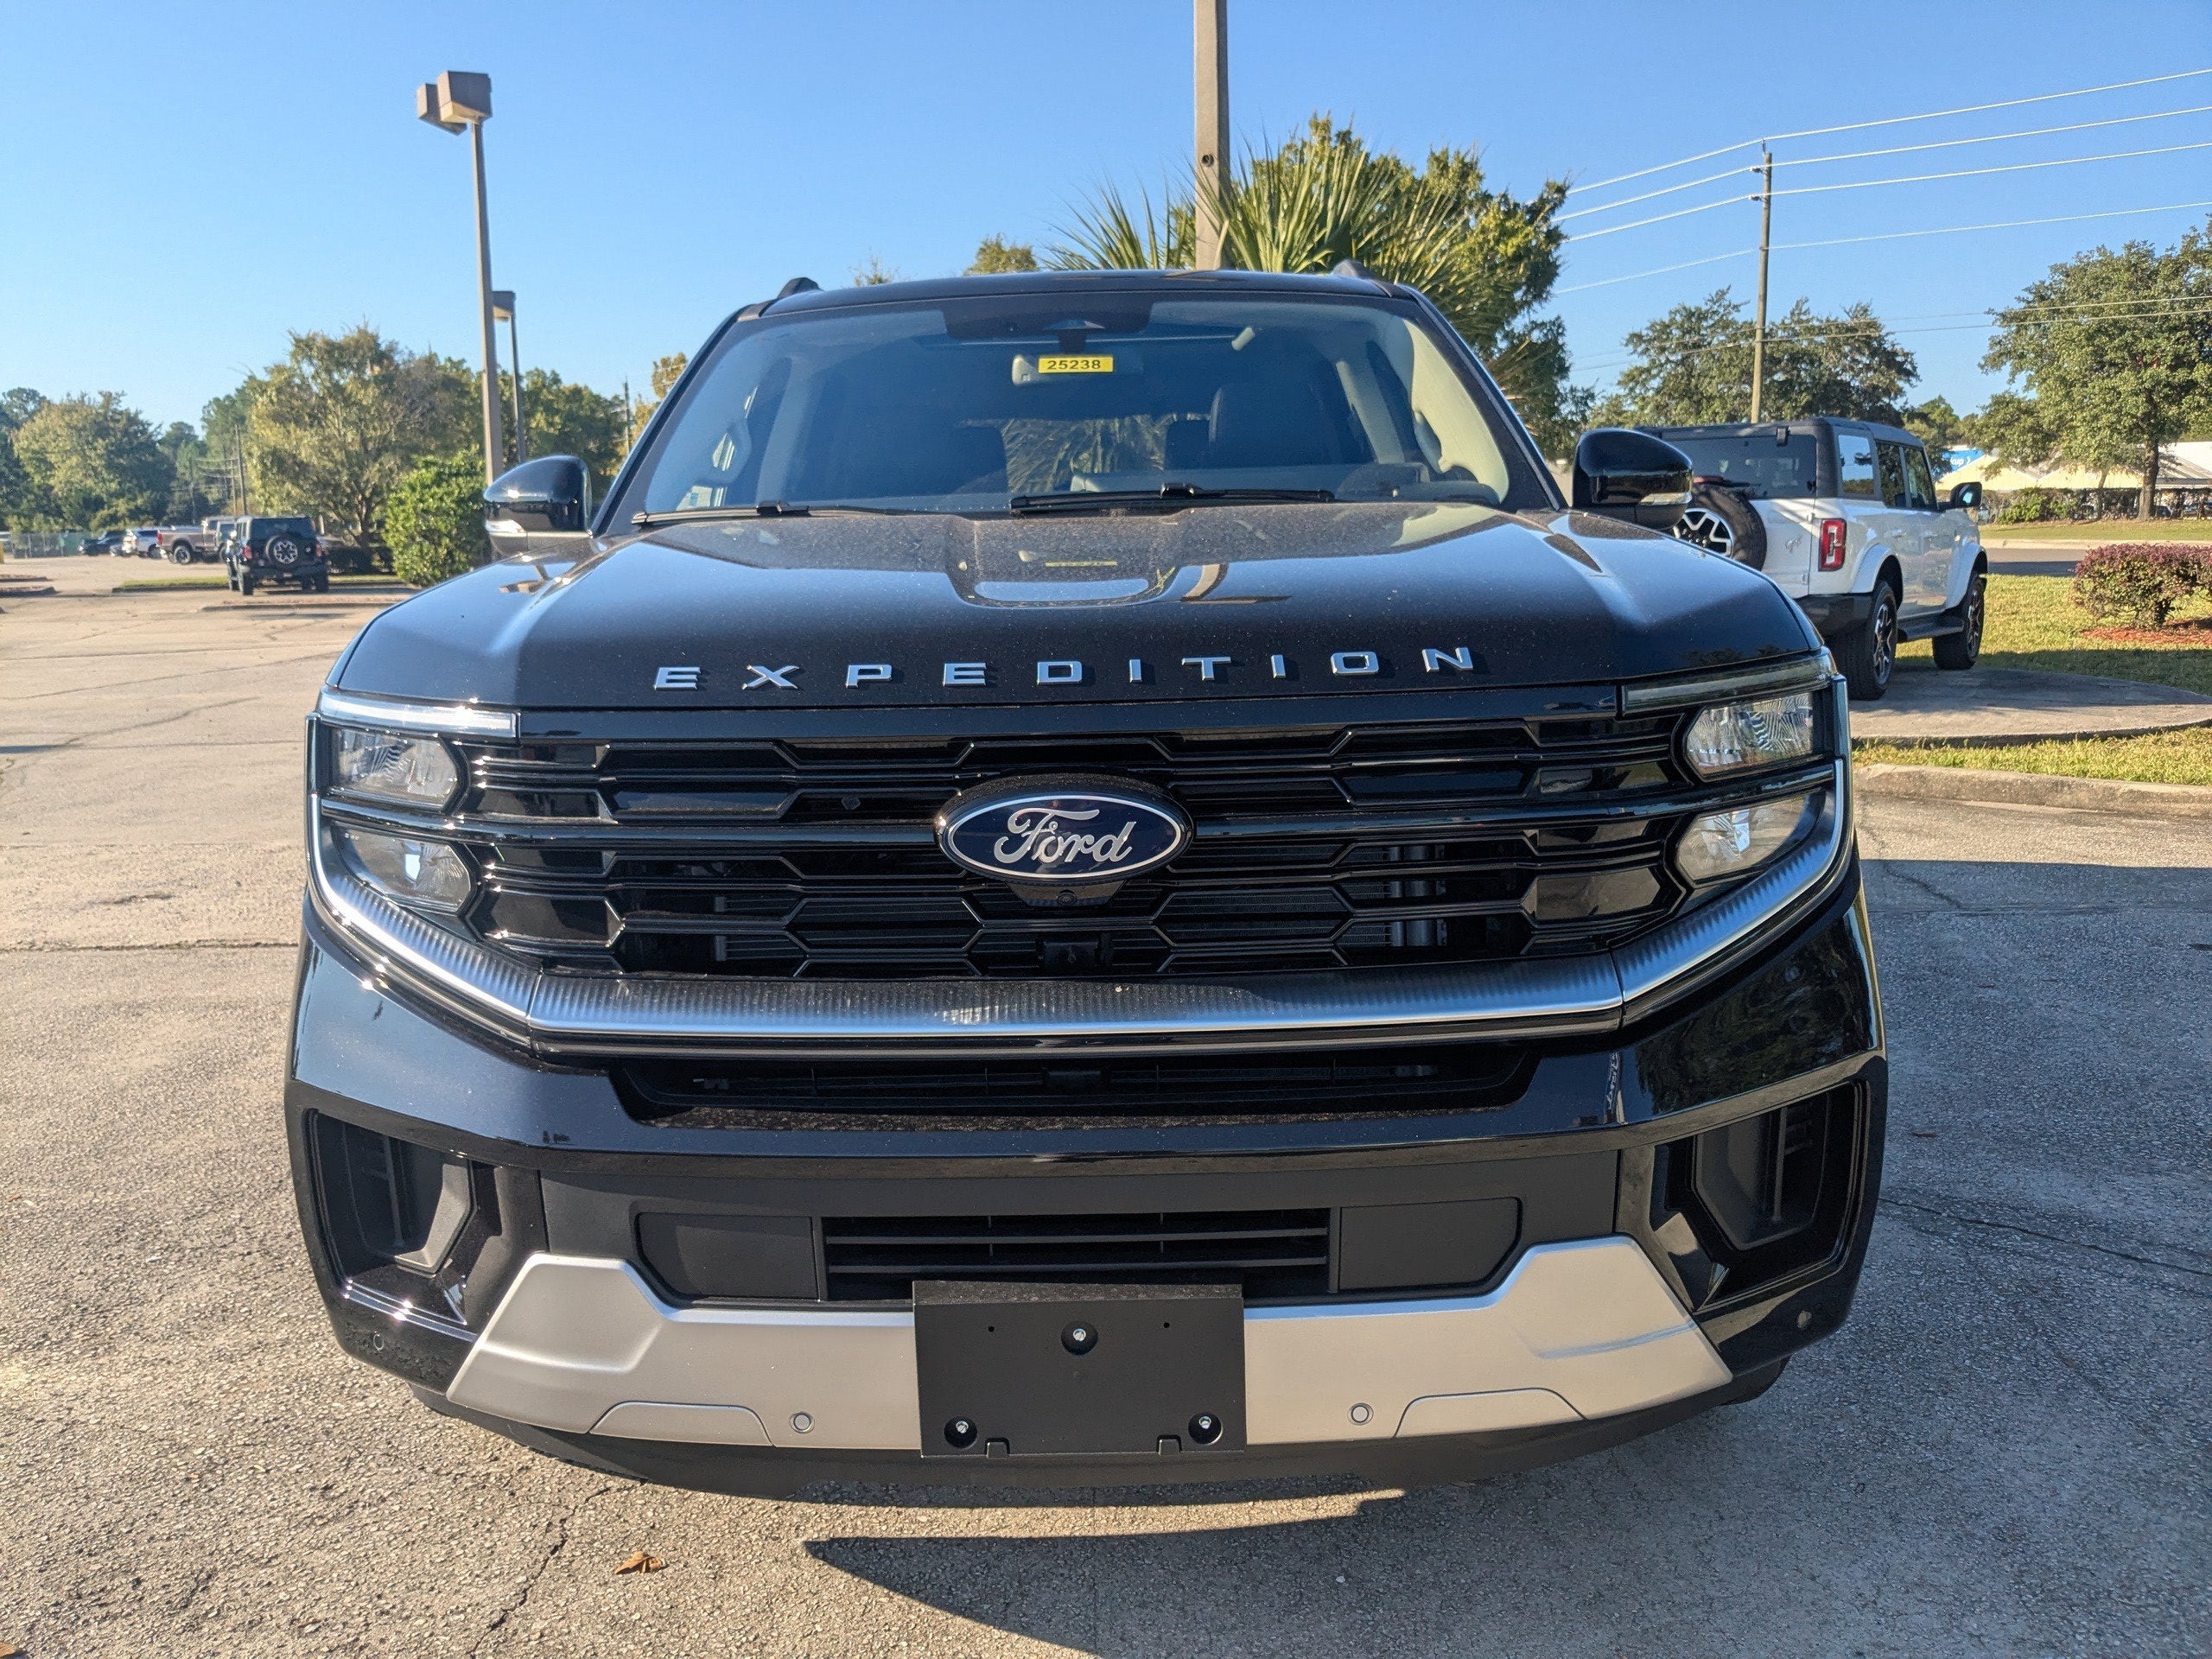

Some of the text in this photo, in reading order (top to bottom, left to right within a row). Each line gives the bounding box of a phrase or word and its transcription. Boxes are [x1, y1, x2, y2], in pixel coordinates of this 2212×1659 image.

[1046, 359, 1102, 371] 25238
[653, 646, 1474, 691] EXPEDITION
[993, 806, 1138, 865] Ford
